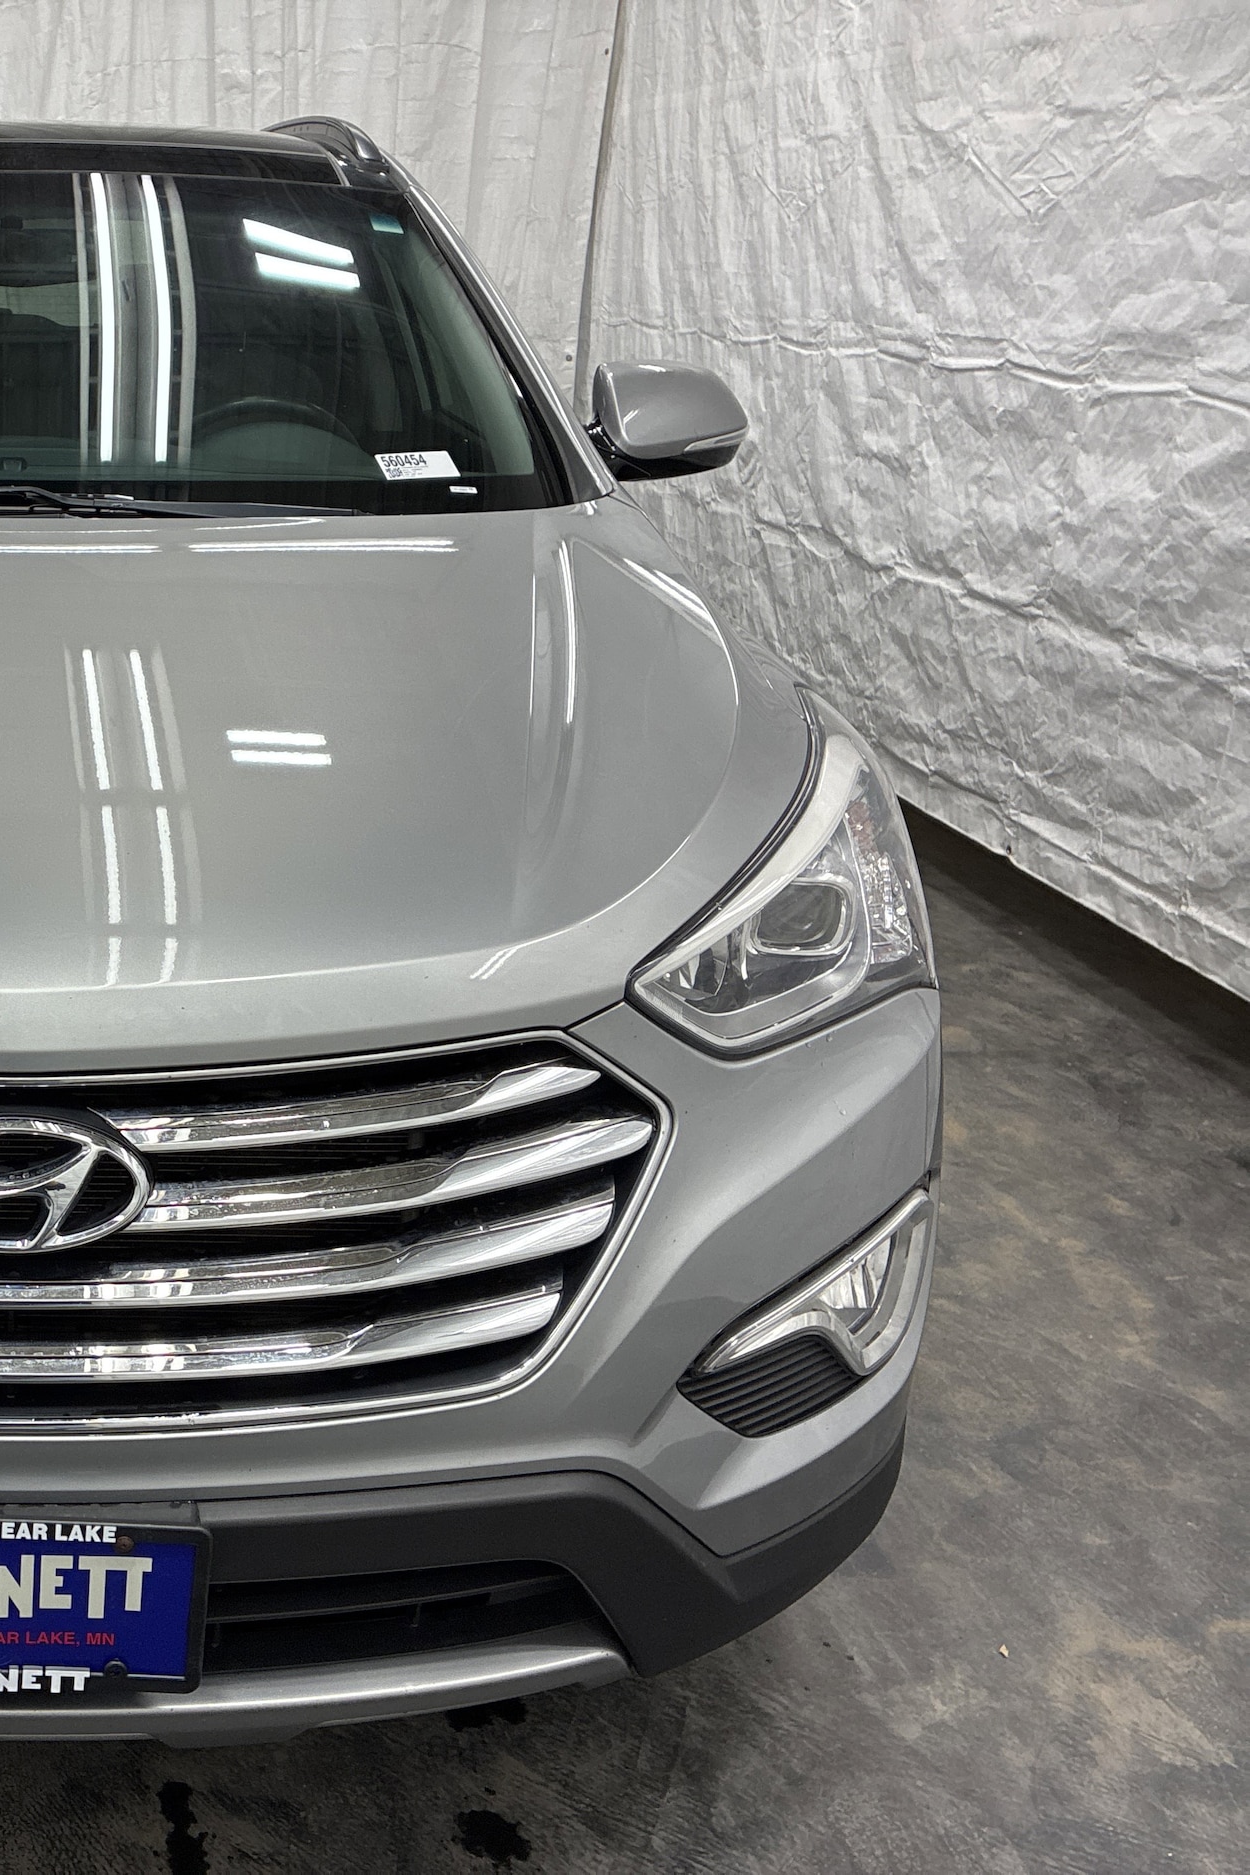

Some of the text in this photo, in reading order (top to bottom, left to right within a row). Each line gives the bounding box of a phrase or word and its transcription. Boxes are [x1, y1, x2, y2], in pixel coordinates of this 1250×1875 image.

[380, 454, 428, 468] 560454
[54, 1524, 117, 1543] LAKE
[25, 1631, 81, 1647] LAKE,
[86, 1632, 115, 1646] MN
